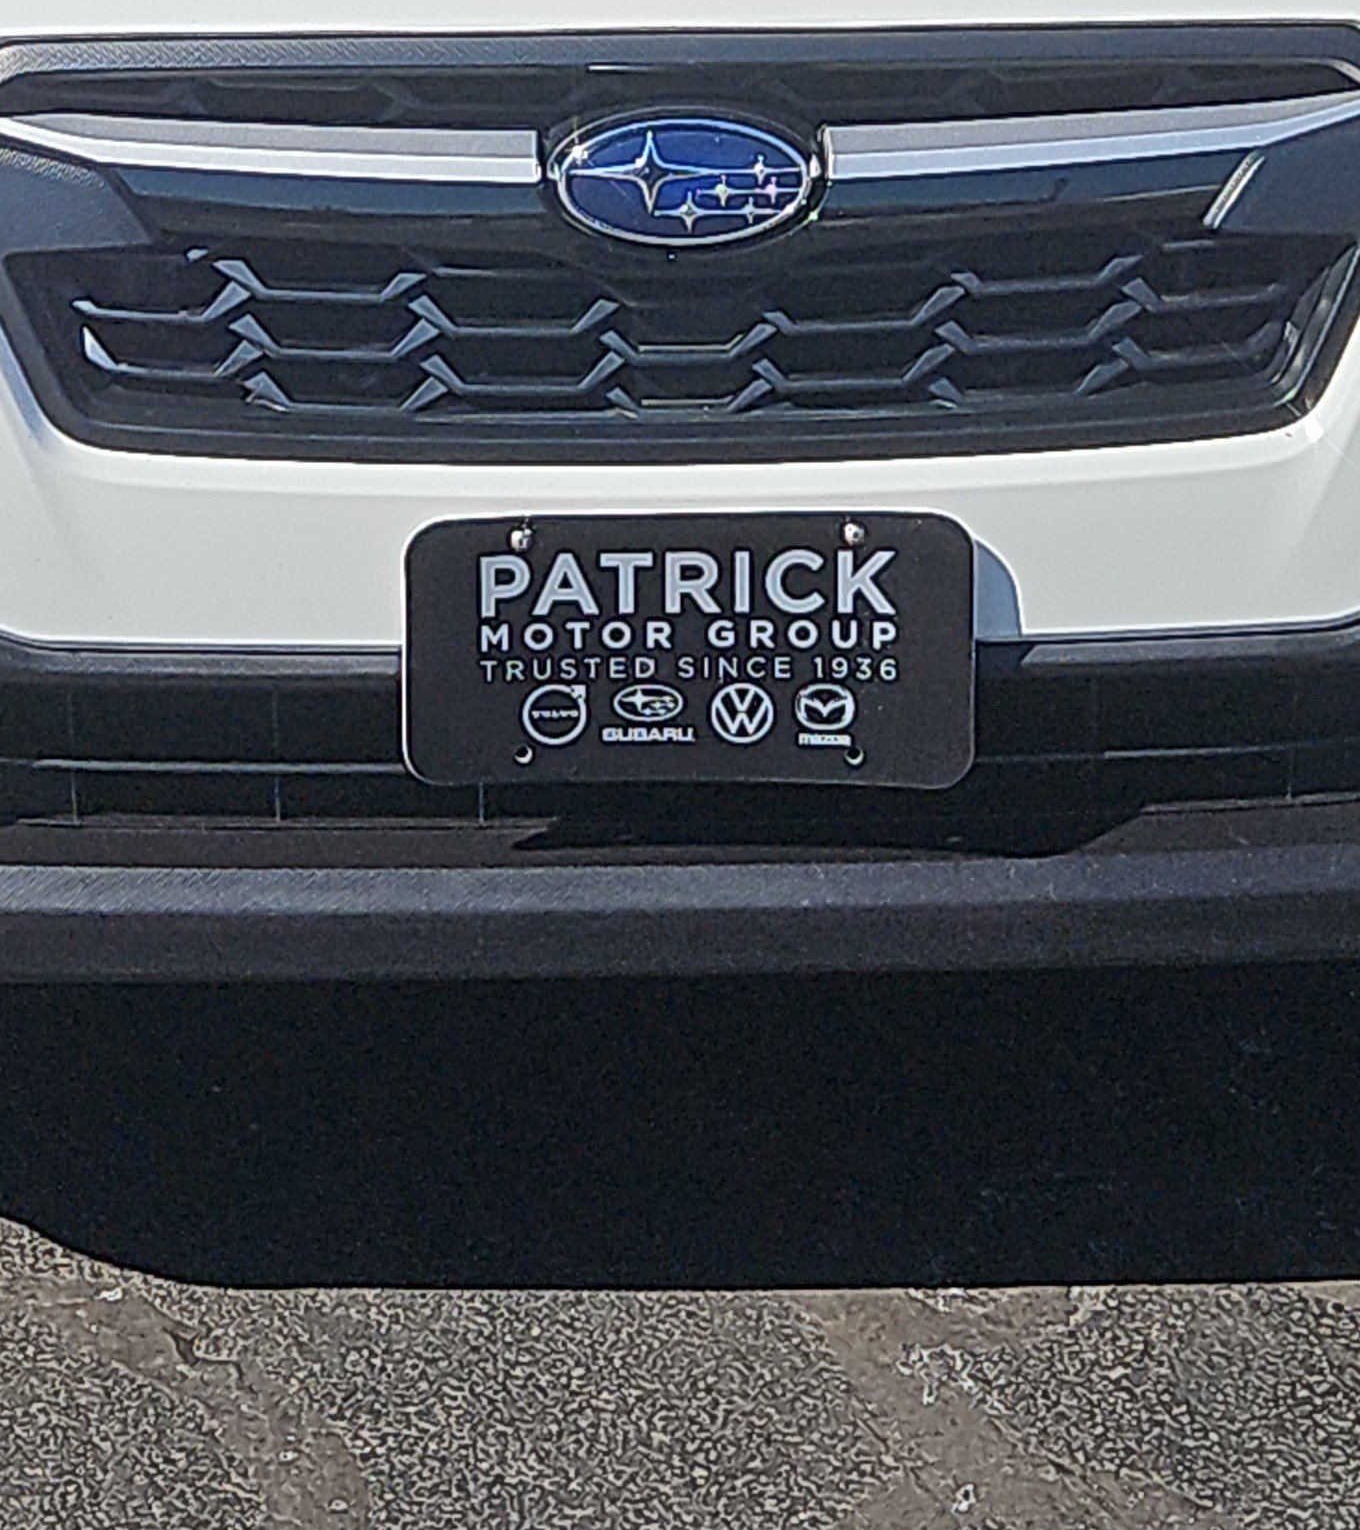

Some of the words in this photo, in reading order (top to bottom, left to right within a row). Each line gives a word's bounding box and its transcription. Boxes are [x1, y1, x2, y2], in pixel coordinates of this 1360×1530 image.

[479, 550, 897, 618] PATRICK
[480, 621, 673, 652] MOTOR
[708, 619, 897, 651] GROUP
[480, 657, 656, 681] TRUSTED
[678, 656, 792, 680] SINCE
[814, 657, 898, 681] 1936
[601, 727, 695, 742] SUBARU
